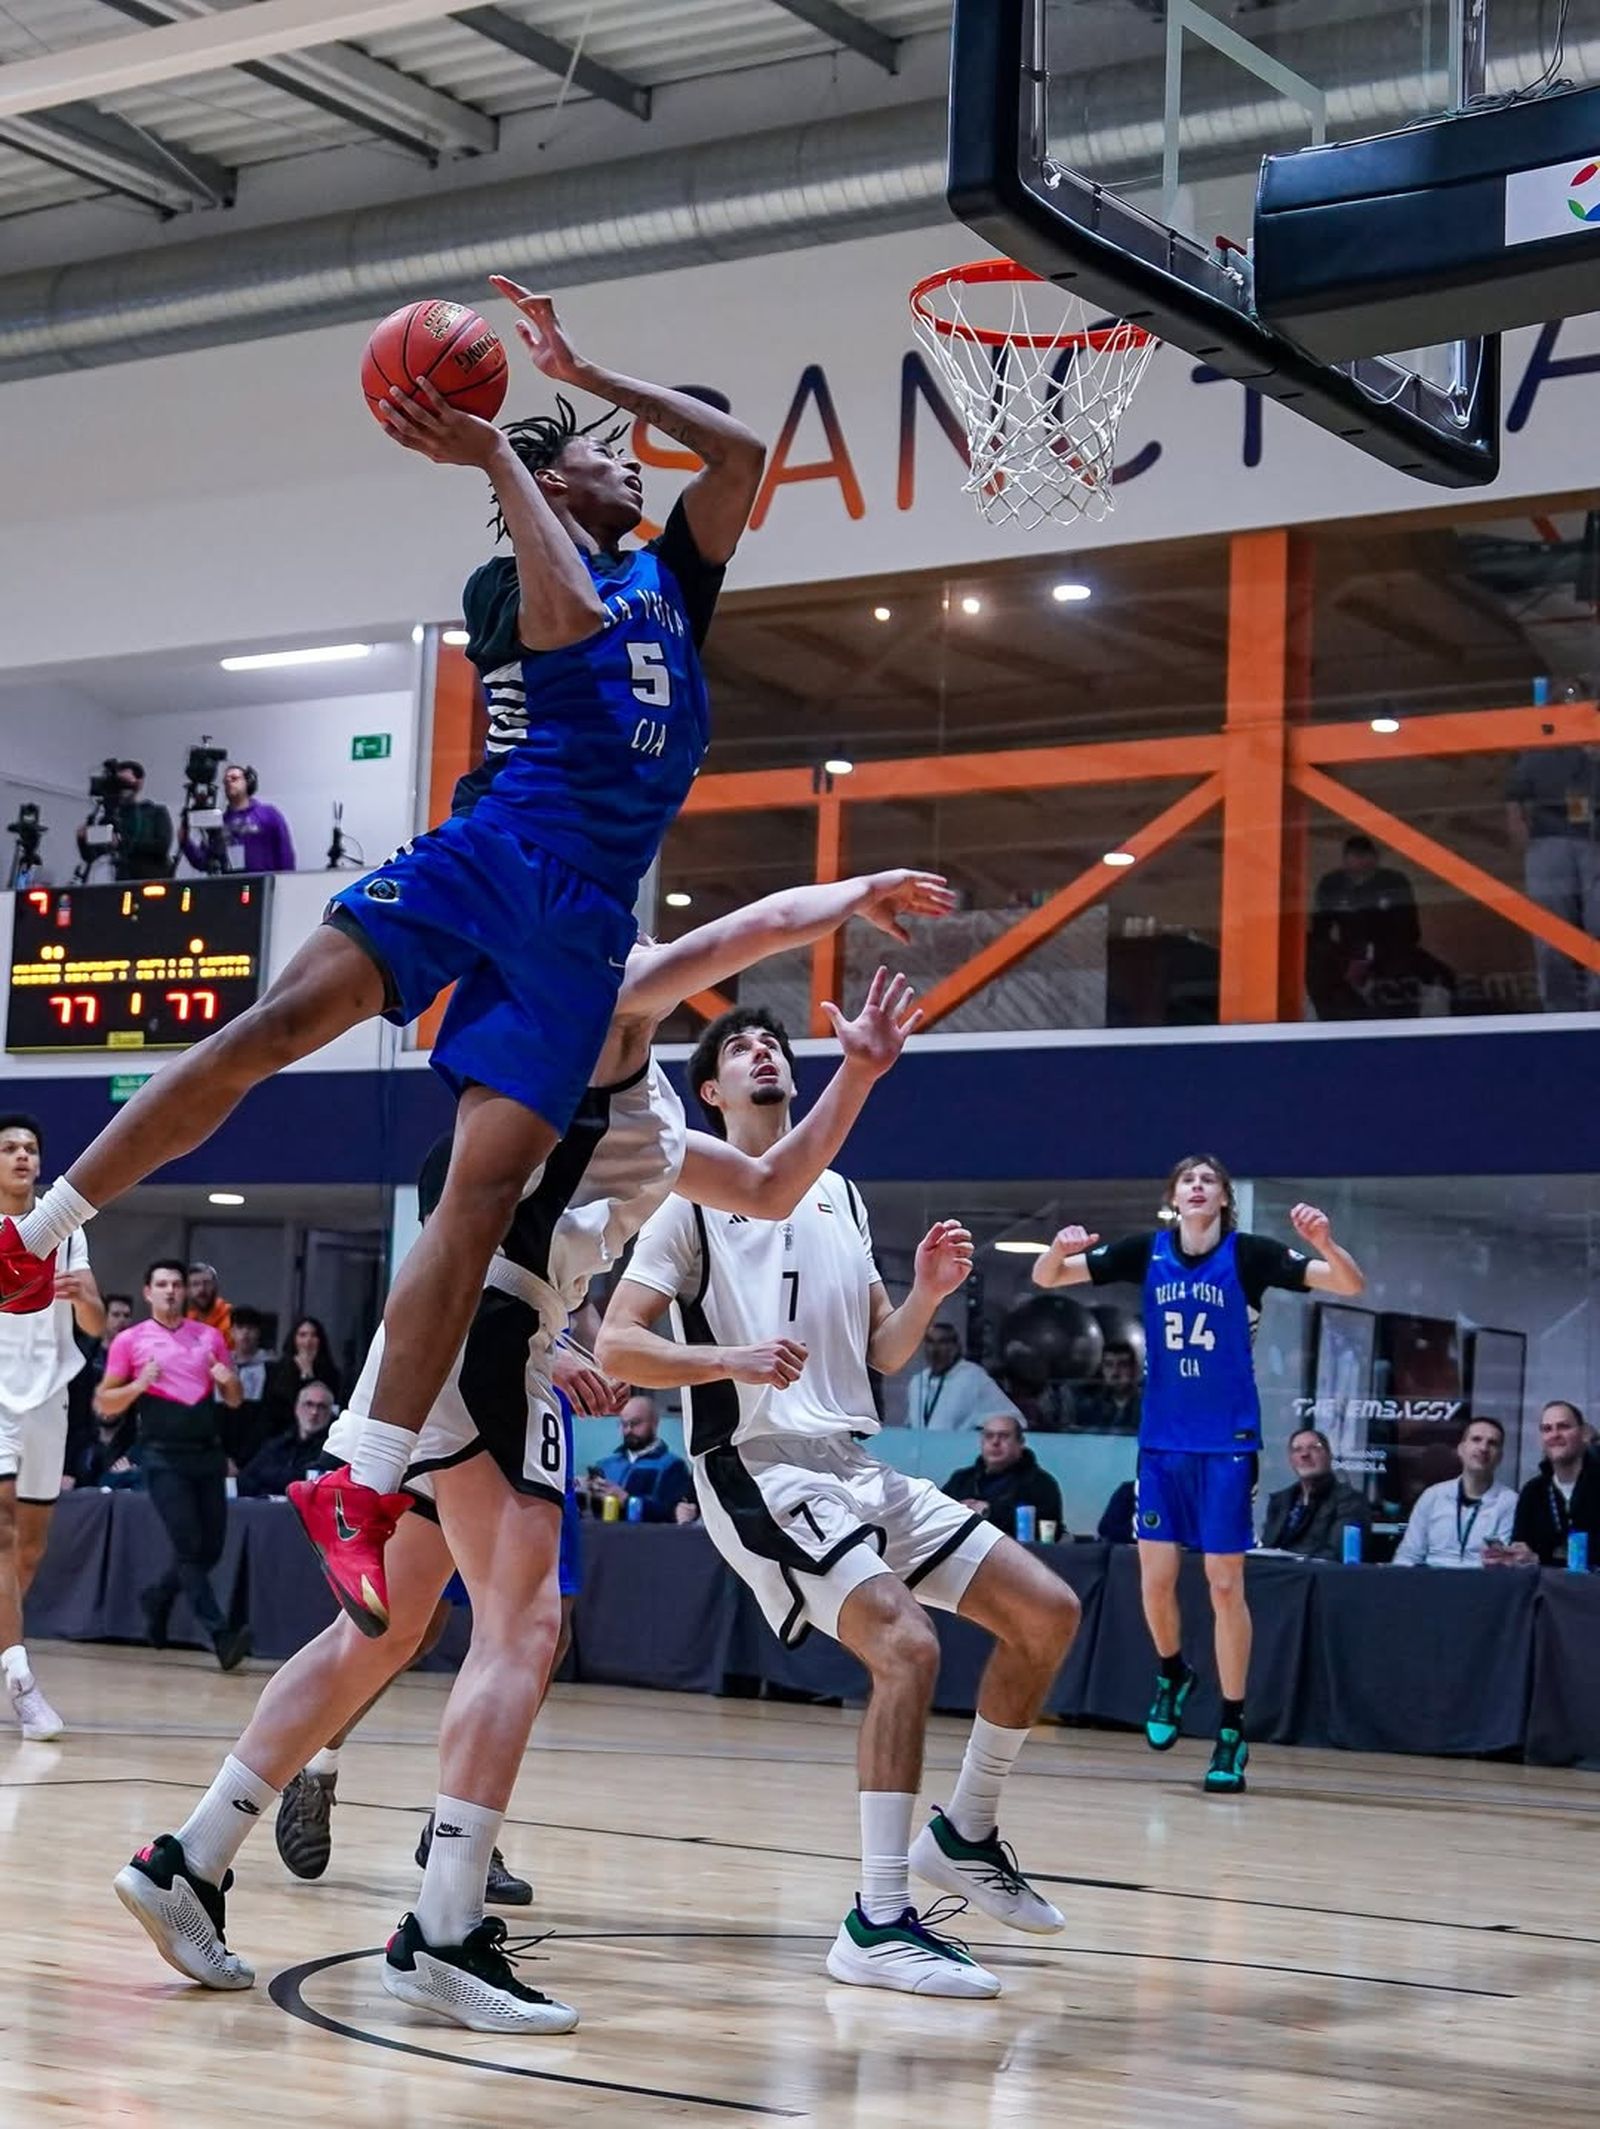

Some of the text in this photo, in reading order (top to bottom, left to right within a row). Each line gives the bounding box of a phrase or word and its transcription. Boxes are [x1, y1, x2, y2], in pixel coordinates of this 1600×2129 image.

[626, 642, 671, 707] 5
[631, 718, 667, 757] CIA
[782, 1271, 799, 1322] 7
[1192, 1281, 1225, 1308] VISTA
[1165, 1311, 1216, 1351] 24
[1180, 1358, 1200, 1377] CIA
[541, 1413, 560, 1472] 8
[789, 1501, 827, 1544] 7
